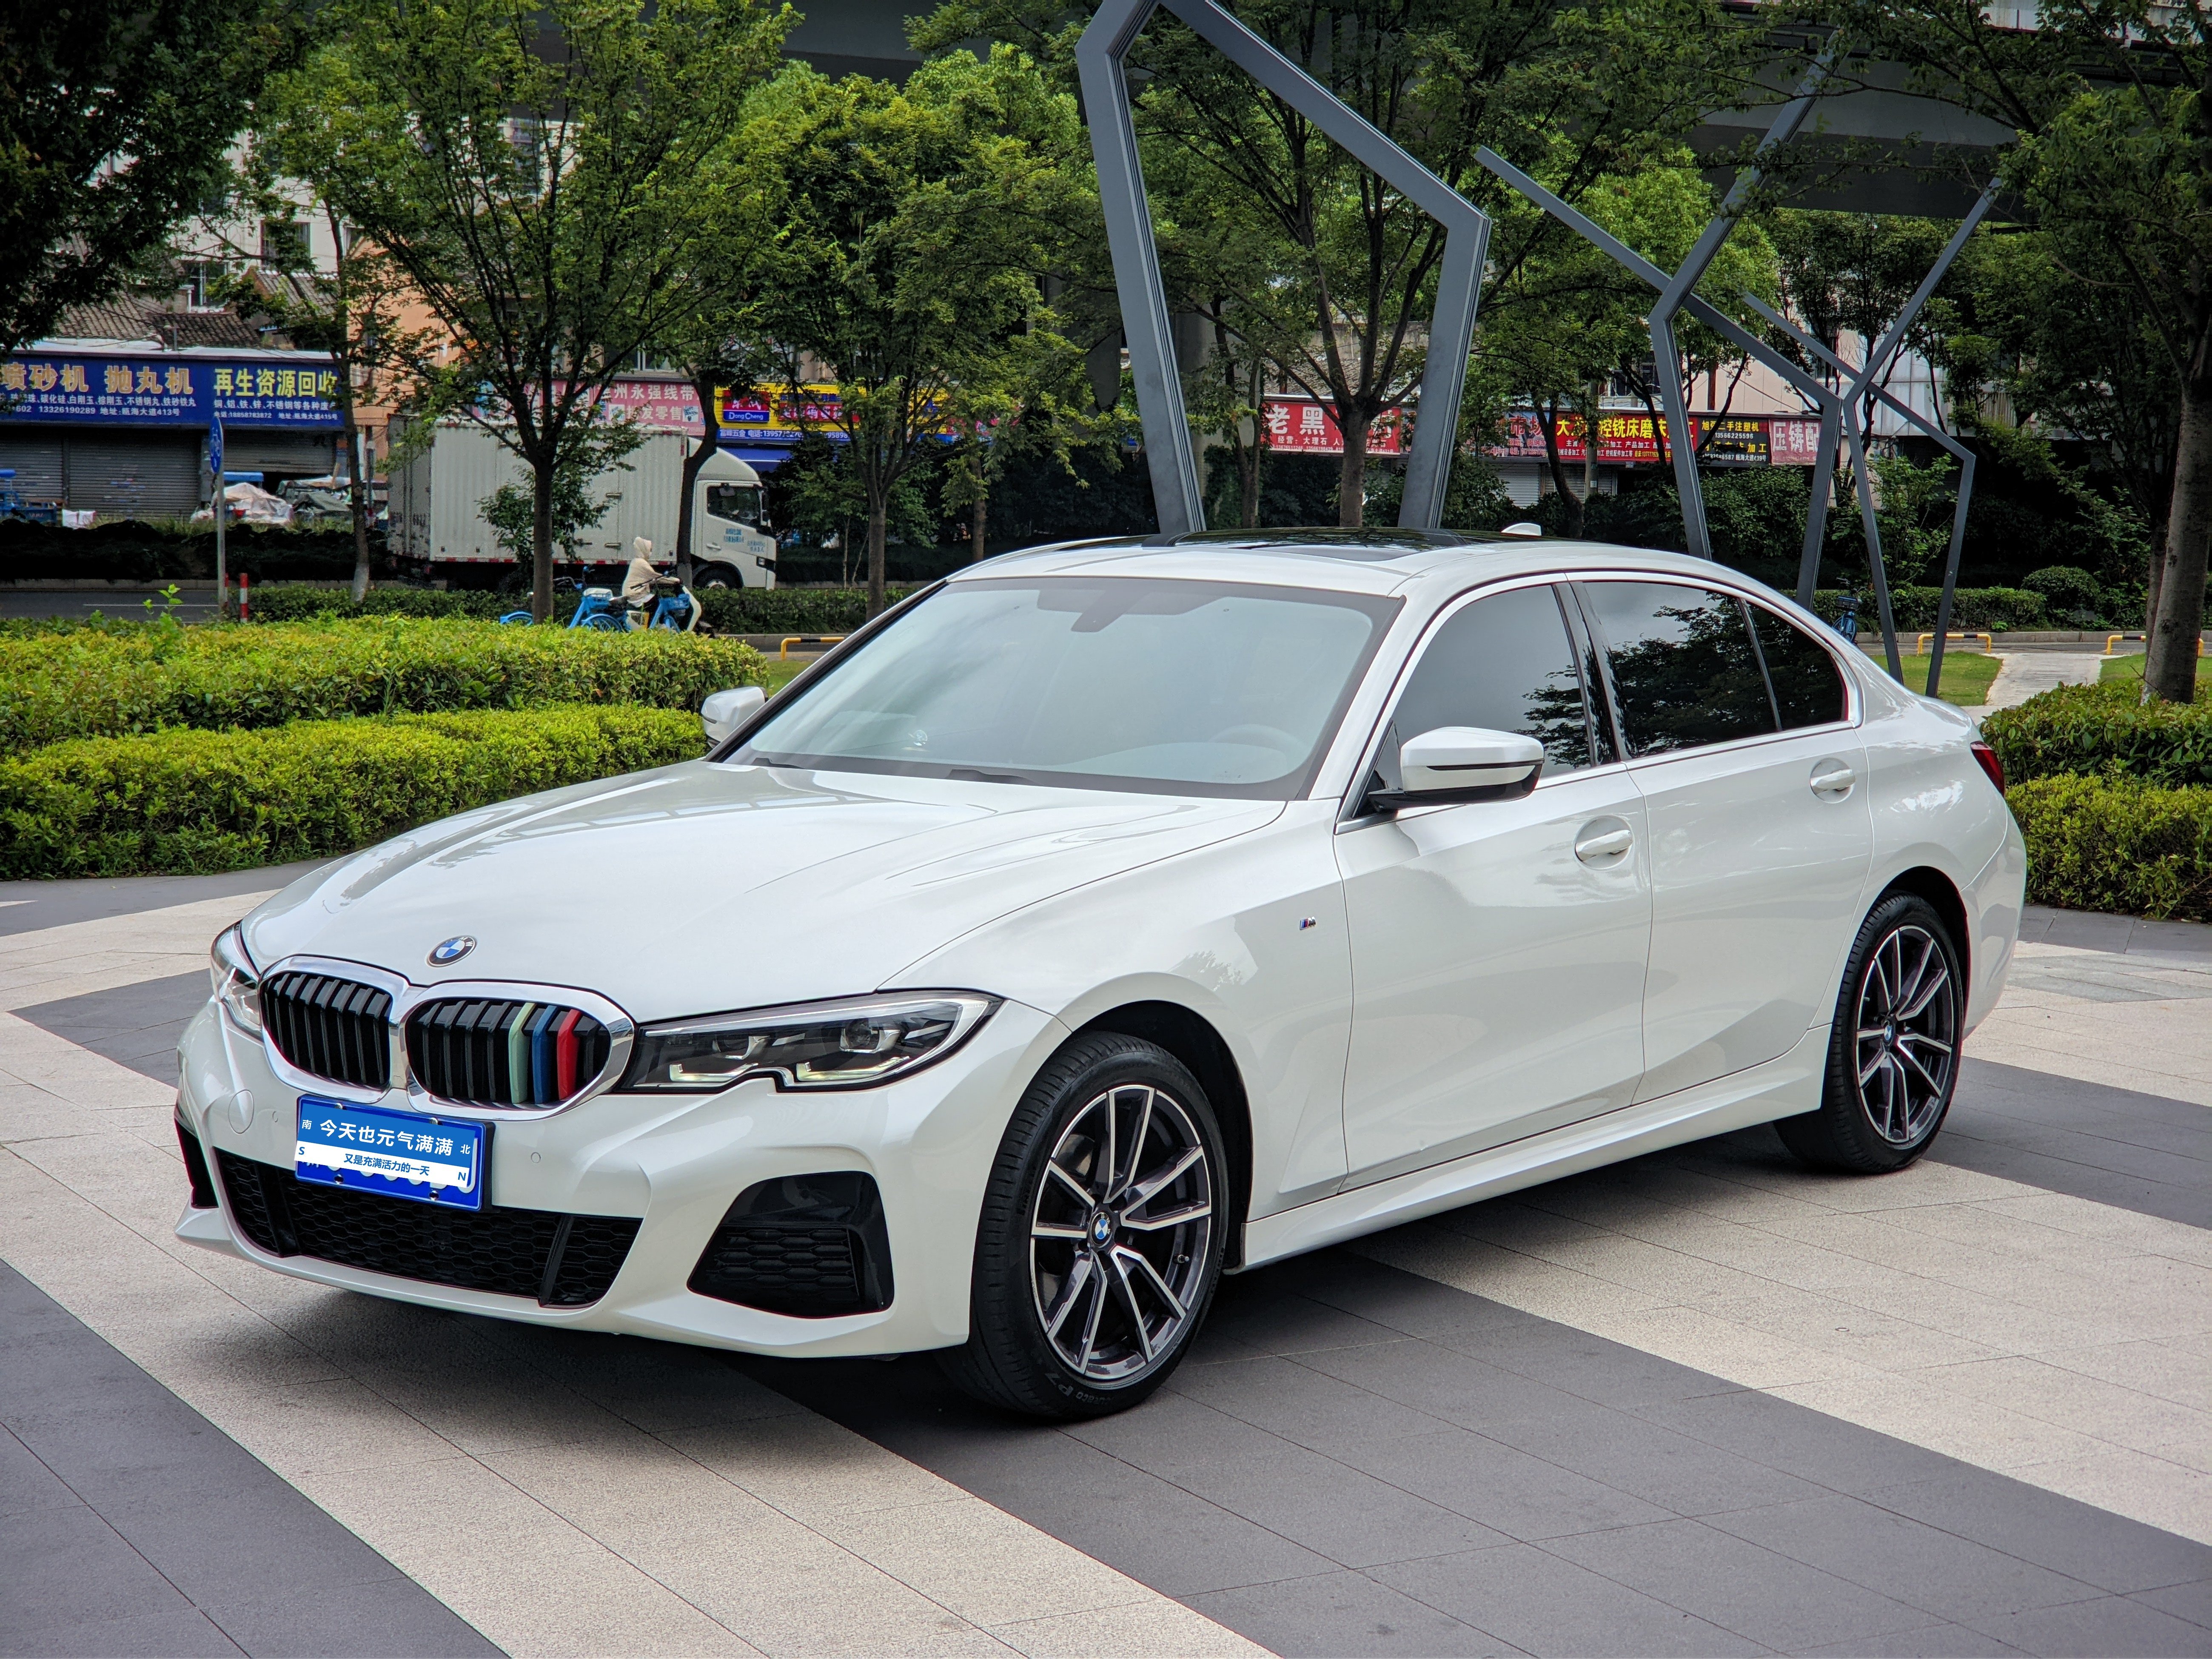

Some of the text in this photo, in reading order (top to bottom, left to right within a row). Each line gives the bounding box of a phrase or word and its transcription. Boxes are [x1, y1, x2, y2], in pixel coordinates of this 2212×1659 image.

[104, 365, 193, 394] 抛丸机
[214, 368, 338, 398] 再生资源回收
[39, 406, 96, 414] 13326190289
[1303, 436, 1328, 445] 大理石
[1773, 421, 1819, 453] 压铸配
